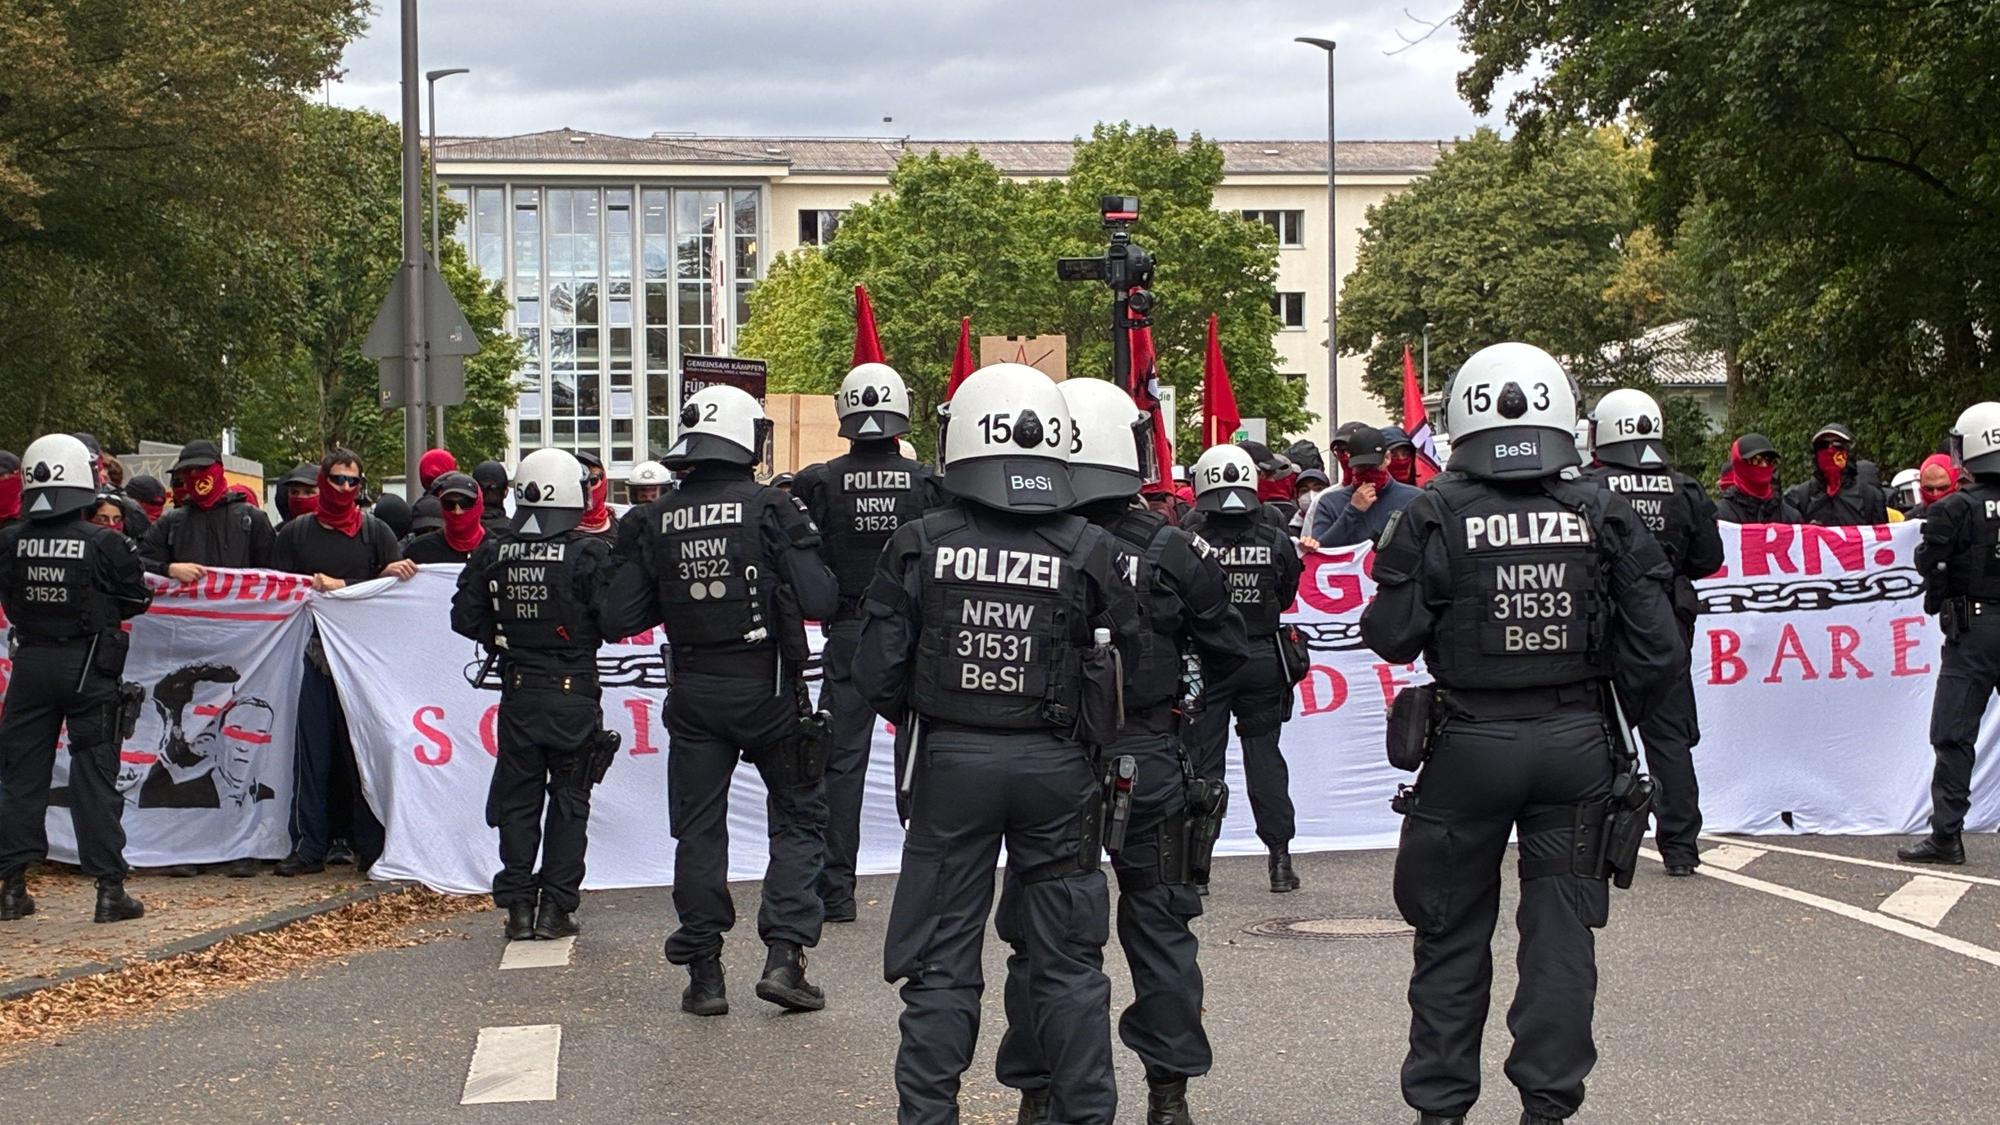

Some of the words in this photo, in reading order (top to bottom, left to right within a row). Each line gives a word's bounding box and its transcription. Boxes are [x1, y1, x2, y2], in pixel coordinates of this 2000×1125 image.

[686, 360, 730, 370] GEMEINSAM
[731, 362, 765, 373] KÄMPFEN
[684, 378, 705, 393] FÜR
[844, 389, 860, 408] 15
[880, 386, 891, 403] 2
[1463, 383, 1492, 416] 15
[1533, 382, 1550, 411] 3
[703, 403, 718, 422] 2
[978, 413, 1012, 445] 15
[1045, 417, 1061, 448] 3
[1615, 418, 1635, 436] 15
[1653, 417, 1660, 433] 2
[1495, 442, 1538, 459] BeSi
[52, 465, 65, 482] 2
[843, 471, 911, 491] POLIZEI
[1011, 475, 1053, 491] BeSi
[1203, 467, 1221, 485] 15
[1241, 466, 1250, 482] 2
[543, 484, 555, 501] 2
[1608, 474, 1674, 494] POLIZEI
[856, 497, 896, 513] NRW
[662, 502, 743, 534] POLIZEI
[854, 515, 898, 531] 31523
[1465, 512, 1590, 550] POLIZEI
[17, 538, 86, 559] POLIZEI
[498, 542, 566, 562] POLIZEI
[680, 538, 727, 560] NRW
[1706, 522, 1896, 579] RN!
[28, 566, 65, 583] NRW
[507, 567, 546, 583] NRW
[679, 558, 730, 581] 31522
[934, 546, 1061, 590] POLIZEI
[1496, 562, 1567, 591] NRW
[26, 586, 68, 602] 31523
[506, 585, 548, 600] 31523
[516, 603, 539, 619] RH
[961, 598, 1036, 631] NRW
[1493, 592, 1573, 620] 31533
[956, 630, 1033, 663] 31531
[1505, 624, 1568, 652] BeSi
[961, 663, 1025, 694] BeSi
